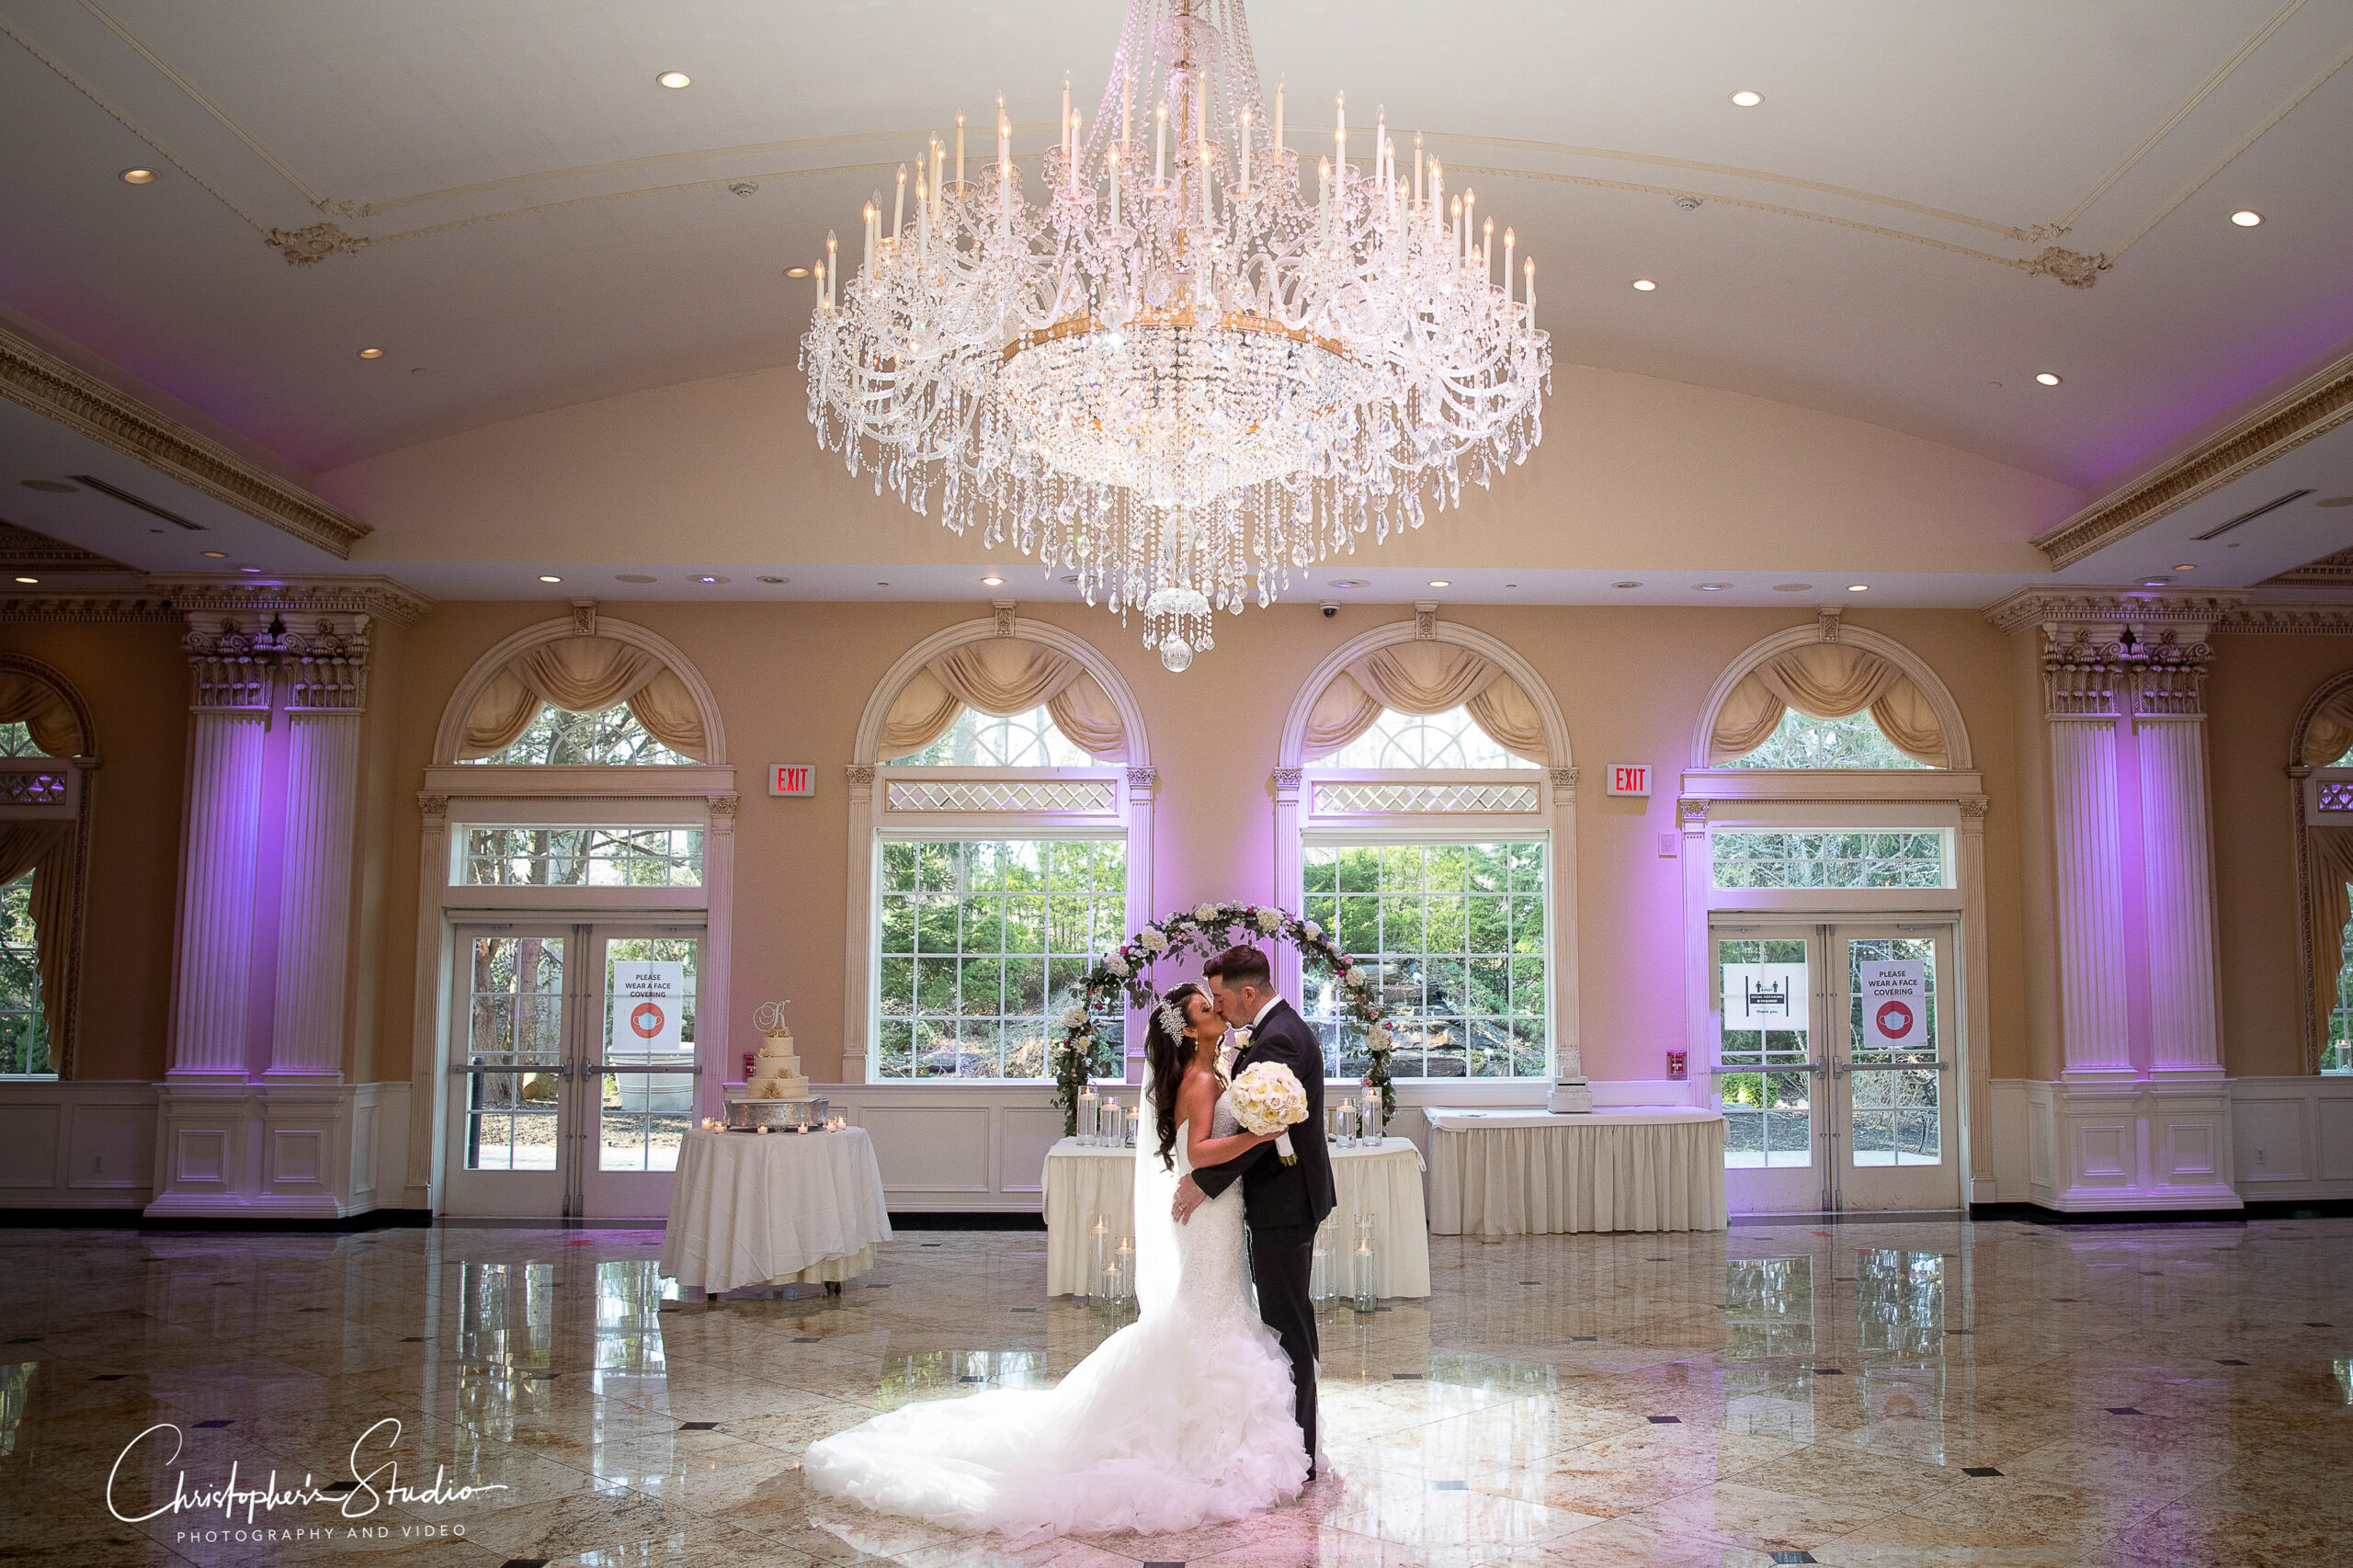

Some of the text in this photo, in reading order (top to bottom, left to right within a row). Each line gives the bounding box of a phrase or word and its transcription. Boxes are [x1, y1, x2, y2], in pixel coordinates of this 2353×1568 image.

[777, 767, 809, 792] EXIT
[1616, 767, 1646, 791] EXIT
[1873, 988, 1914, 996] COVERING
